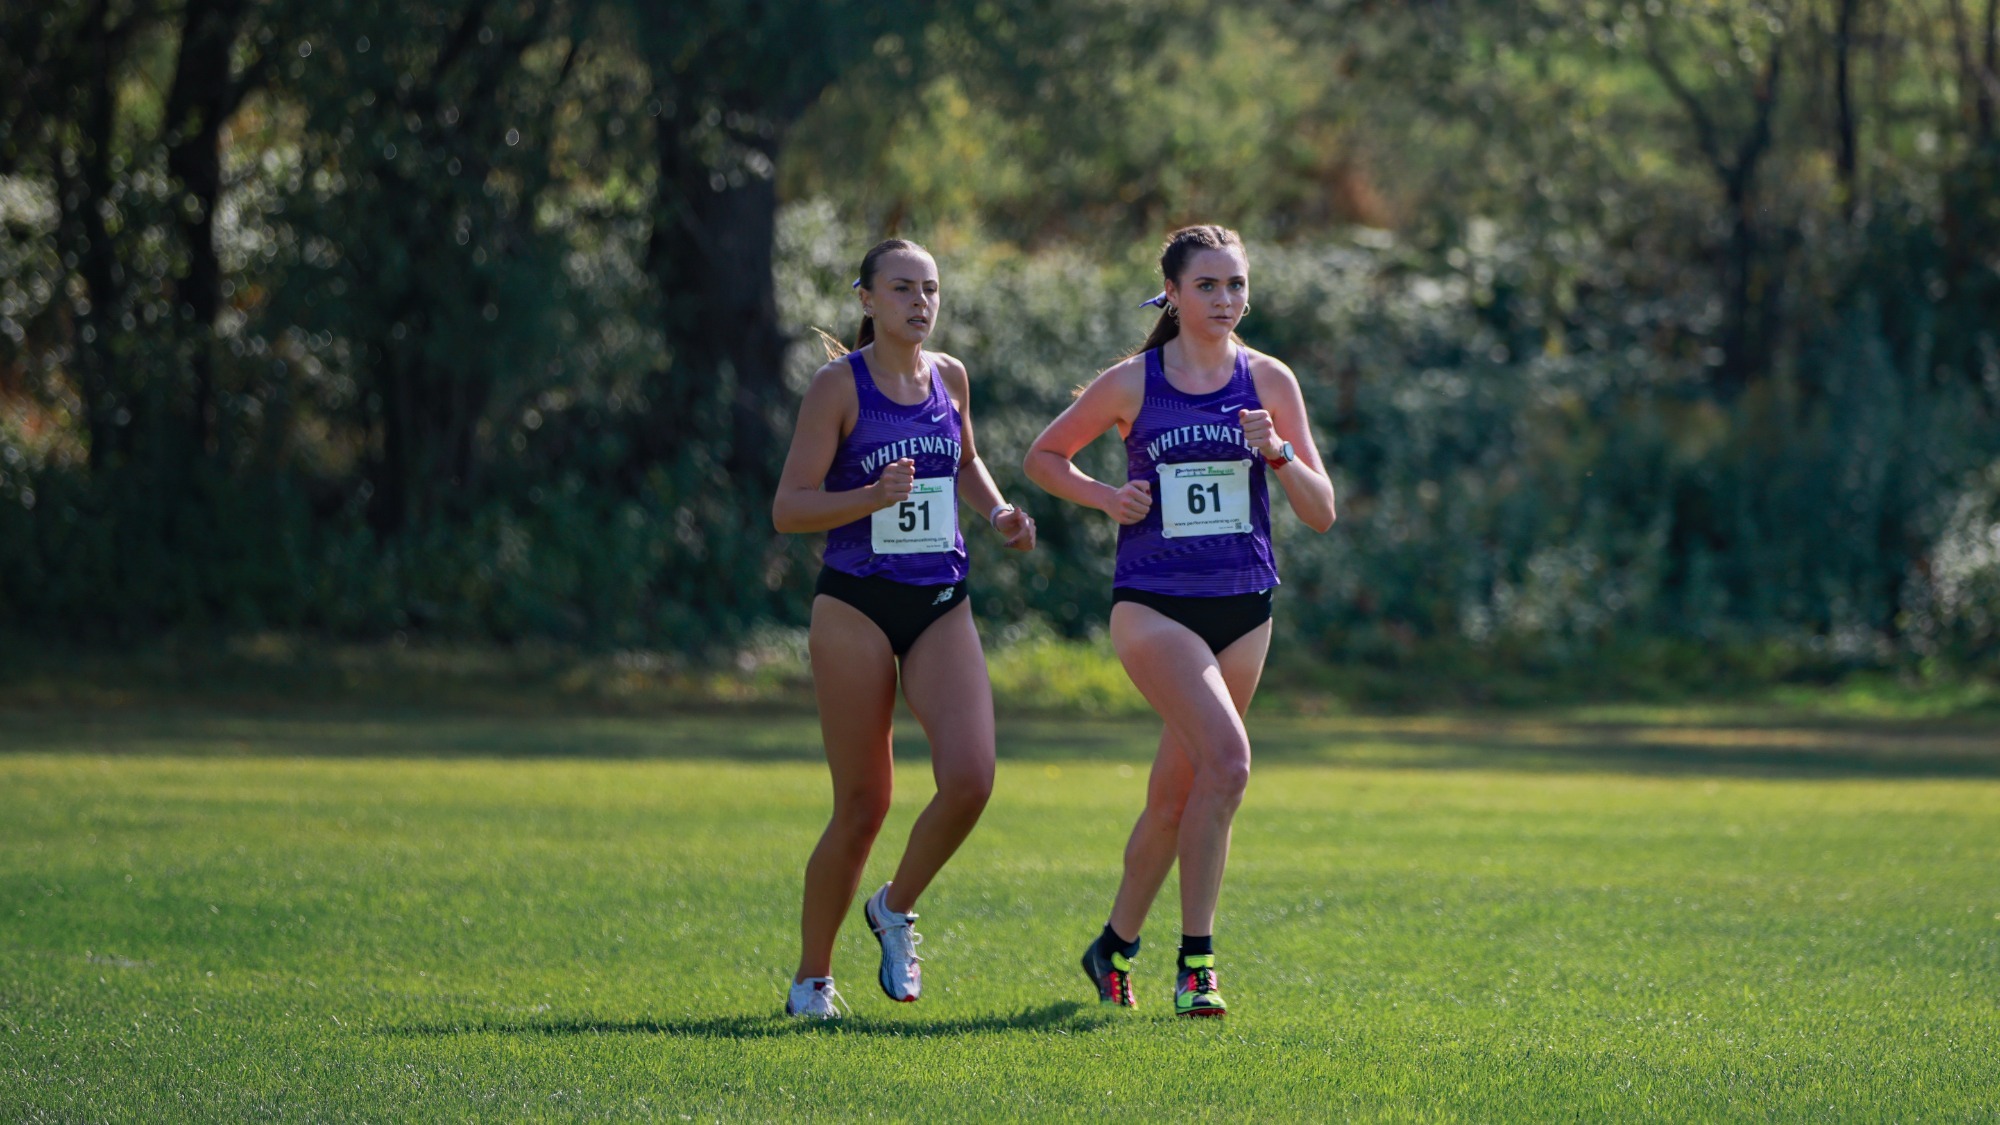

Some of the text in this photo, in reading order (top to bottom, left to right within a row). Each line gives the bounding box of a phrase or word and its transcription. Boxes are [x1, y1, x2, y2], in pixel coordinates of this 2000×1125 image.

[861, 436, 961, 474] WHITEWATE
[1187, 483, 1221, 514] 61
[898, 500, 930, 532] 51
